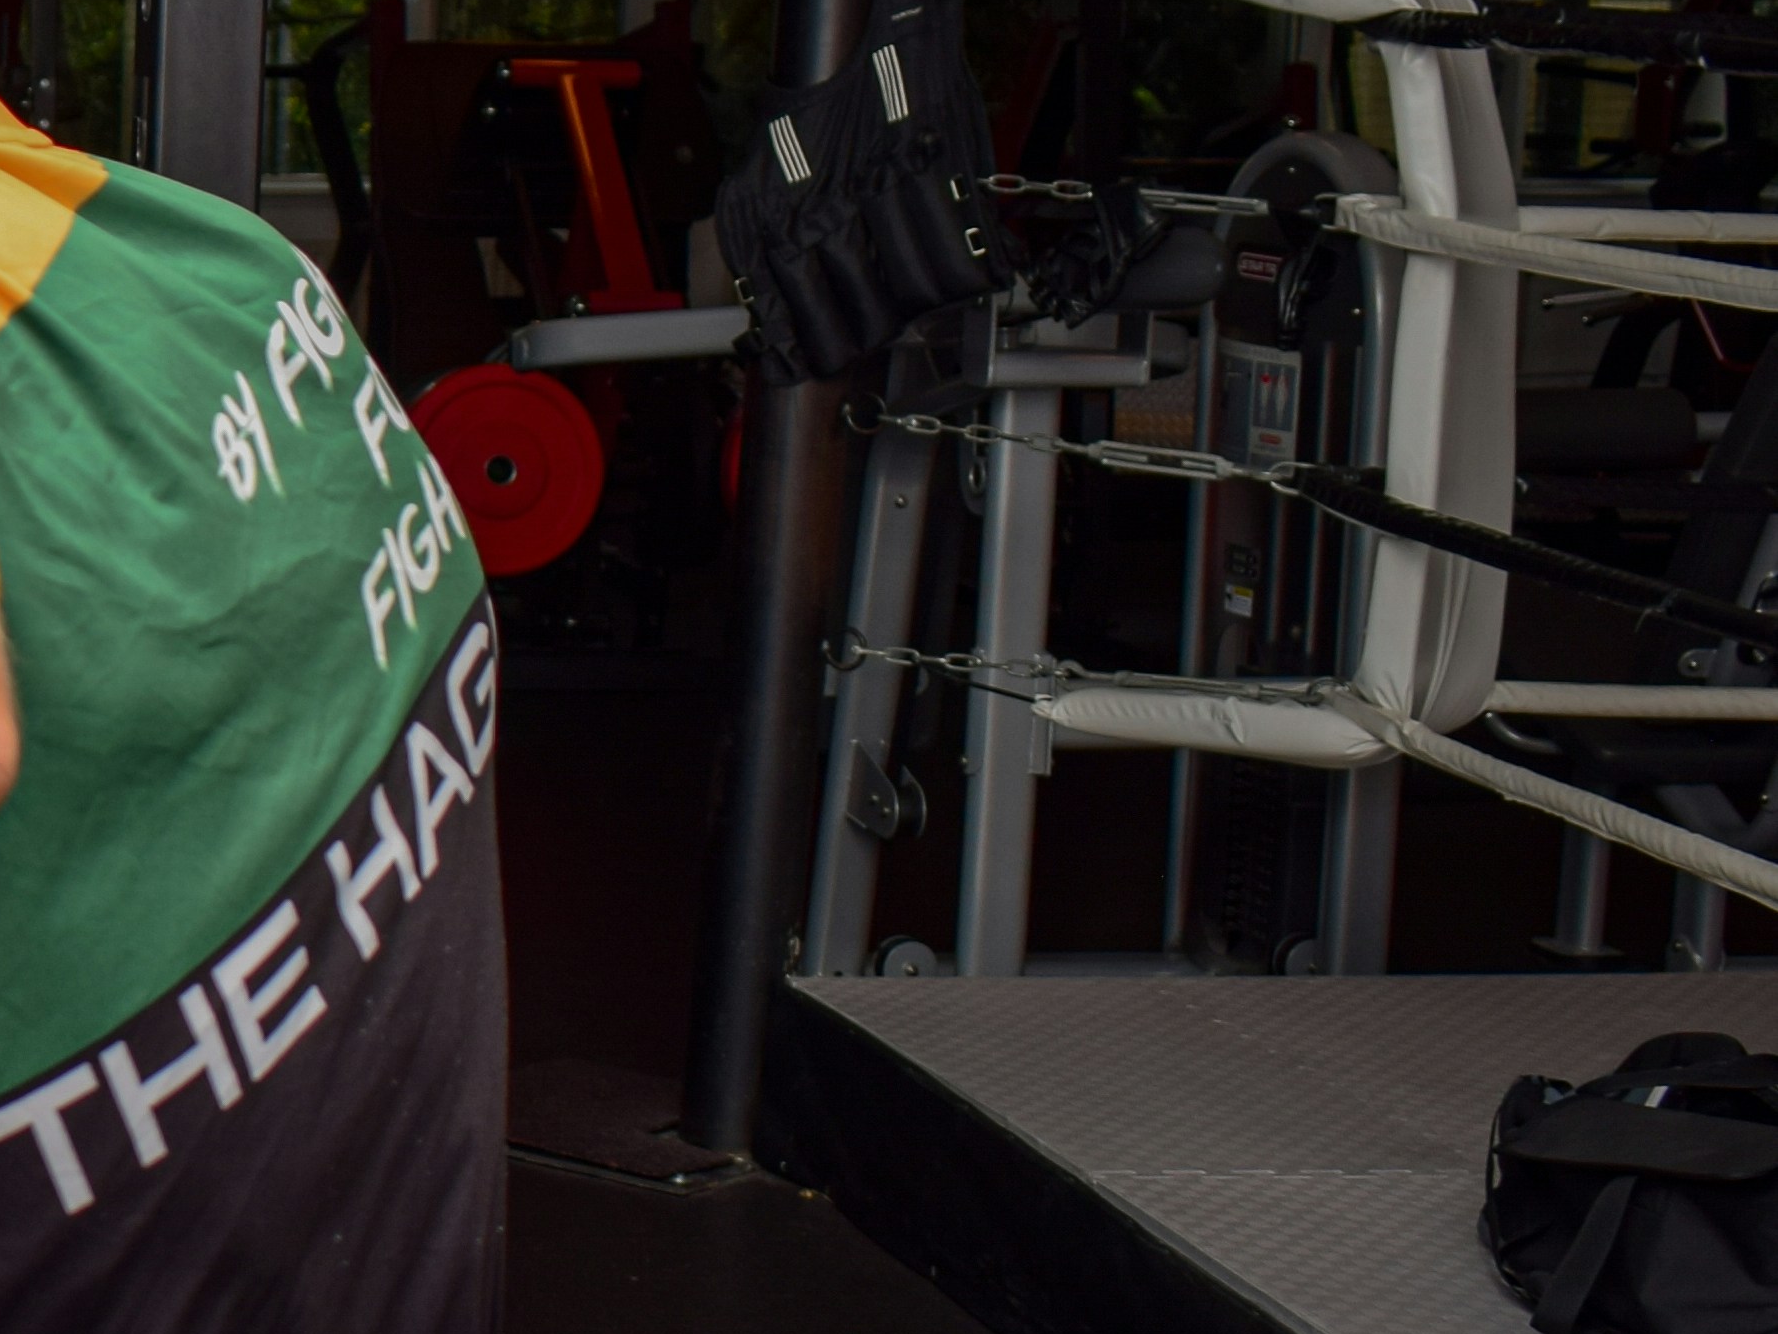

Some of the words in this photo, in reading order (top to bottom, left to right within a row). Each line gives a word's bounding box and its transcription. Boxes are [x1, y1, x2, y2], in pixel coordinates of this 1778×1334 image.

[212, 370, 287, 503] BY
[265, 244, 345, 431] FIG
[361, 454, 466, 670] FIGH
[324, 594, 499, 960] HAG
